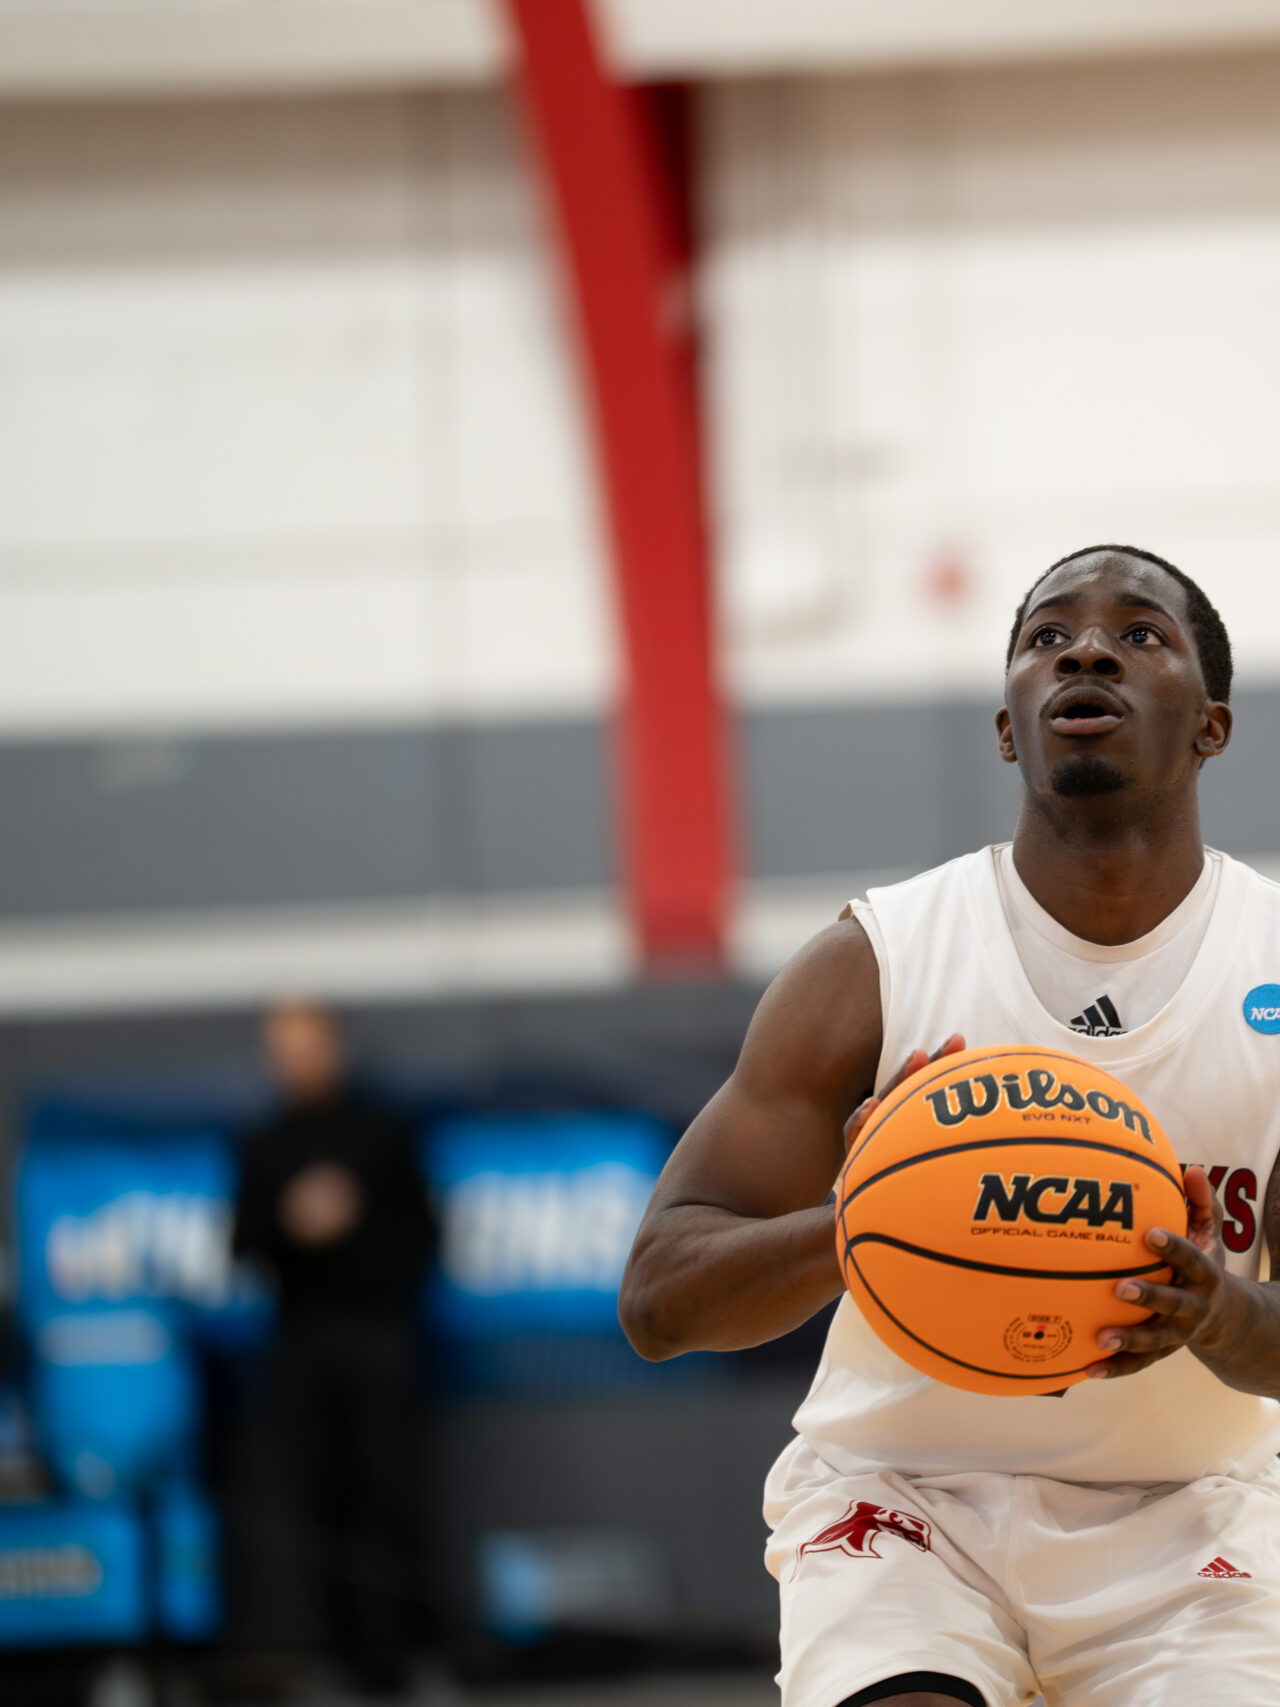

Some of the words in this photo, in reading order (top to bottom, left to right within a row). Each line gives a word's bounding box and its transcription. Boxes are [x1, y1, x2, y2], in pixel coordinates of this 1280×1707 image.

[925, 1069, 1155, 1143] Wilson
[1022, 1113, 1056, 1122] EVO
[1060, 1114, 1092, 1125] NXT
[971, 1173, 1134, 1230] NCAA
[970, 1227, 1043, 1237] OFFICIAL
[1046, 1229, 1092, 1240] GAME
[1095, 1232, 1132, 1244] BALL
[1197, 1571, 1252, 1579] adidas
